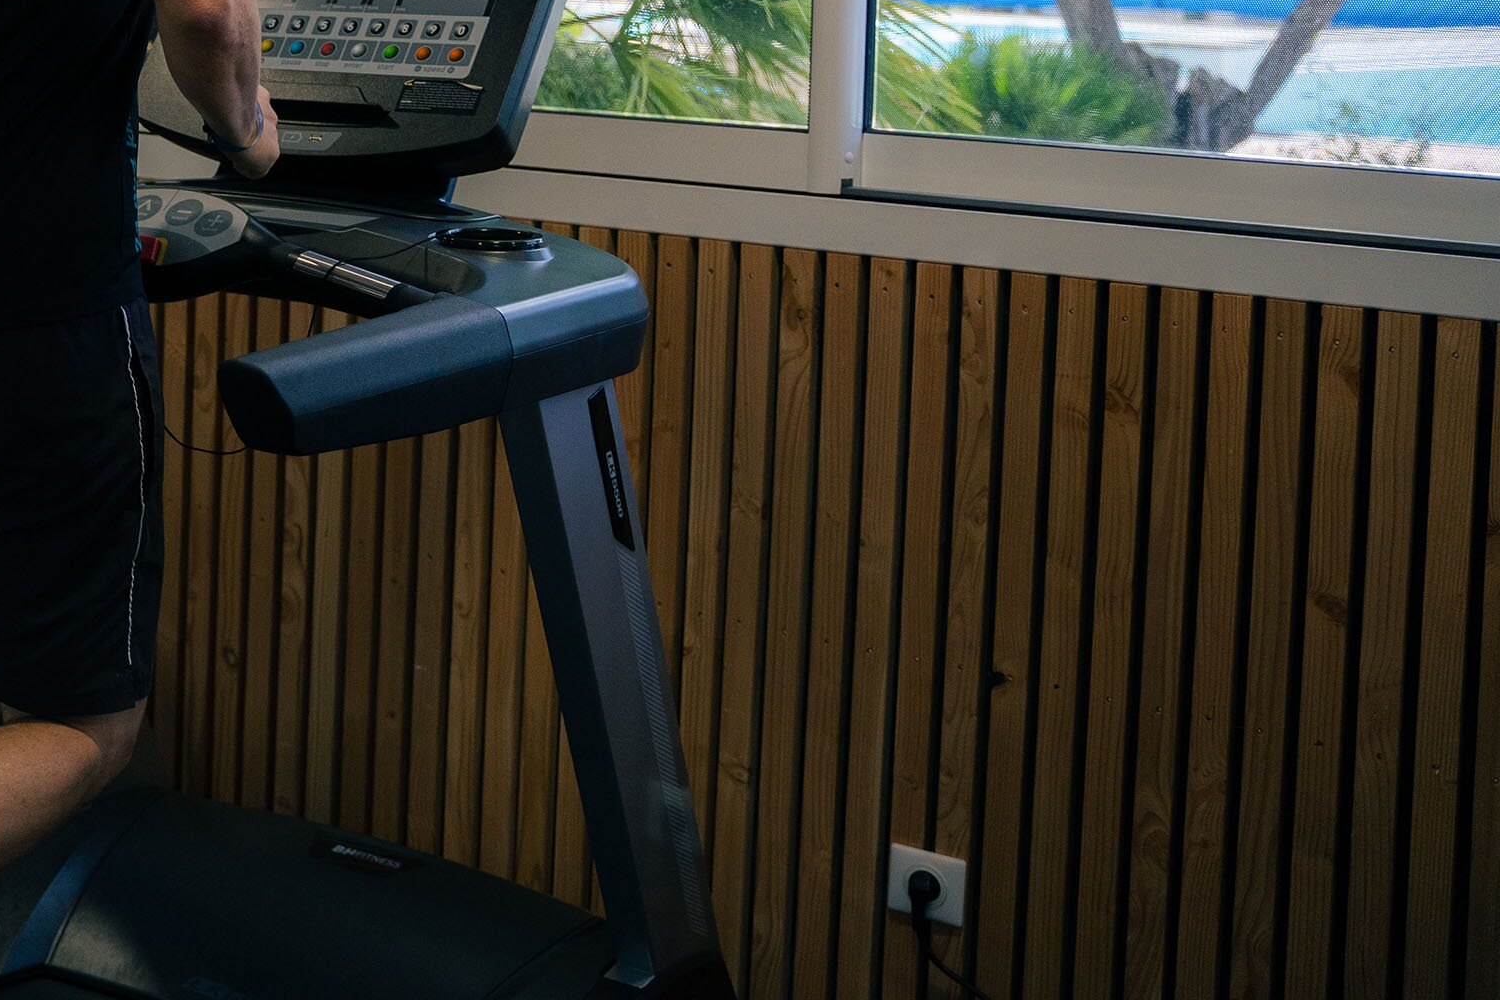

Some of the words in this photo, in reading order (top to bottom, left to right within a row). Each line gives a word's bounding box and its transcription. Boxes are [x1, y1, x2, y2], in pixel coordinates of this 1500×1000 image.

[320, 20, 329, 30] 5
[347, 22, 355, 31] 6
[375, 23, 382, 32] 7
[401, 24, 409, 33] 8
[430, 25, 438, 34] 9
[458, 26, 466, 36] 0
